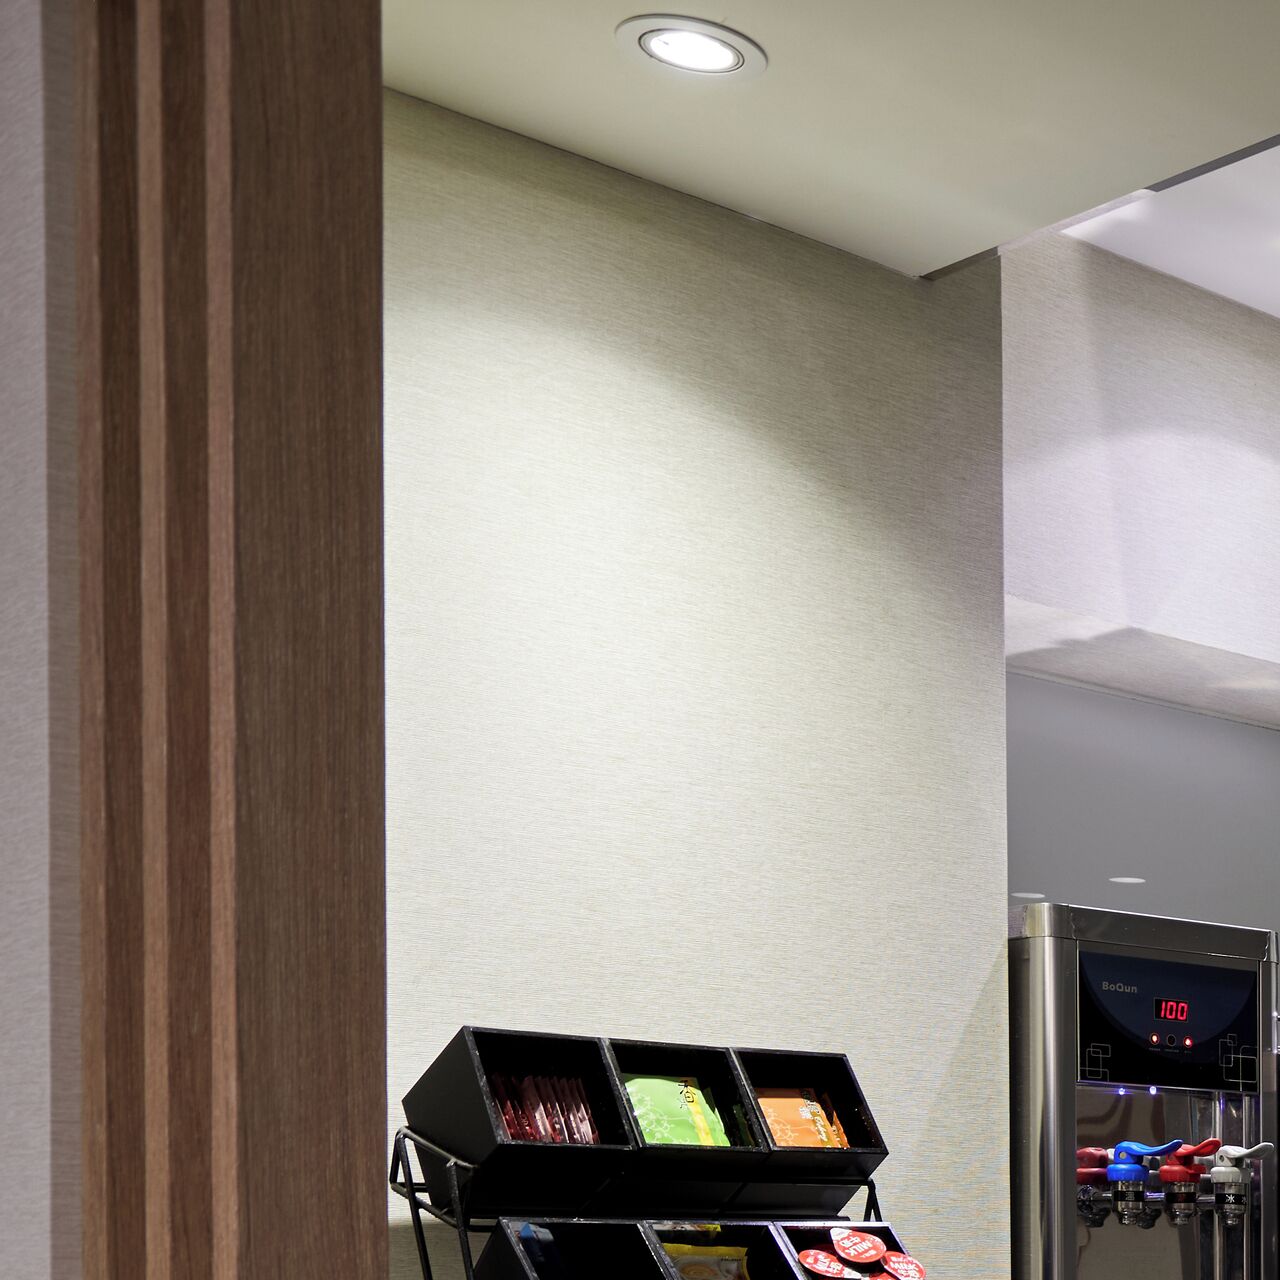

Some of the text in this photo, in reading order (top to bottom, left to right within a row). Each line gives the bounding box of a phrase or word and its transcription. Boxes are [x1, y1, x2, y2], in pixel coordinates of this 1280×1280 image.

[1102, 981, 1138, 993] BoQun
[1160, 1001, 1189, 1021] 100
[845, 1240, 873, 1257] MILK
